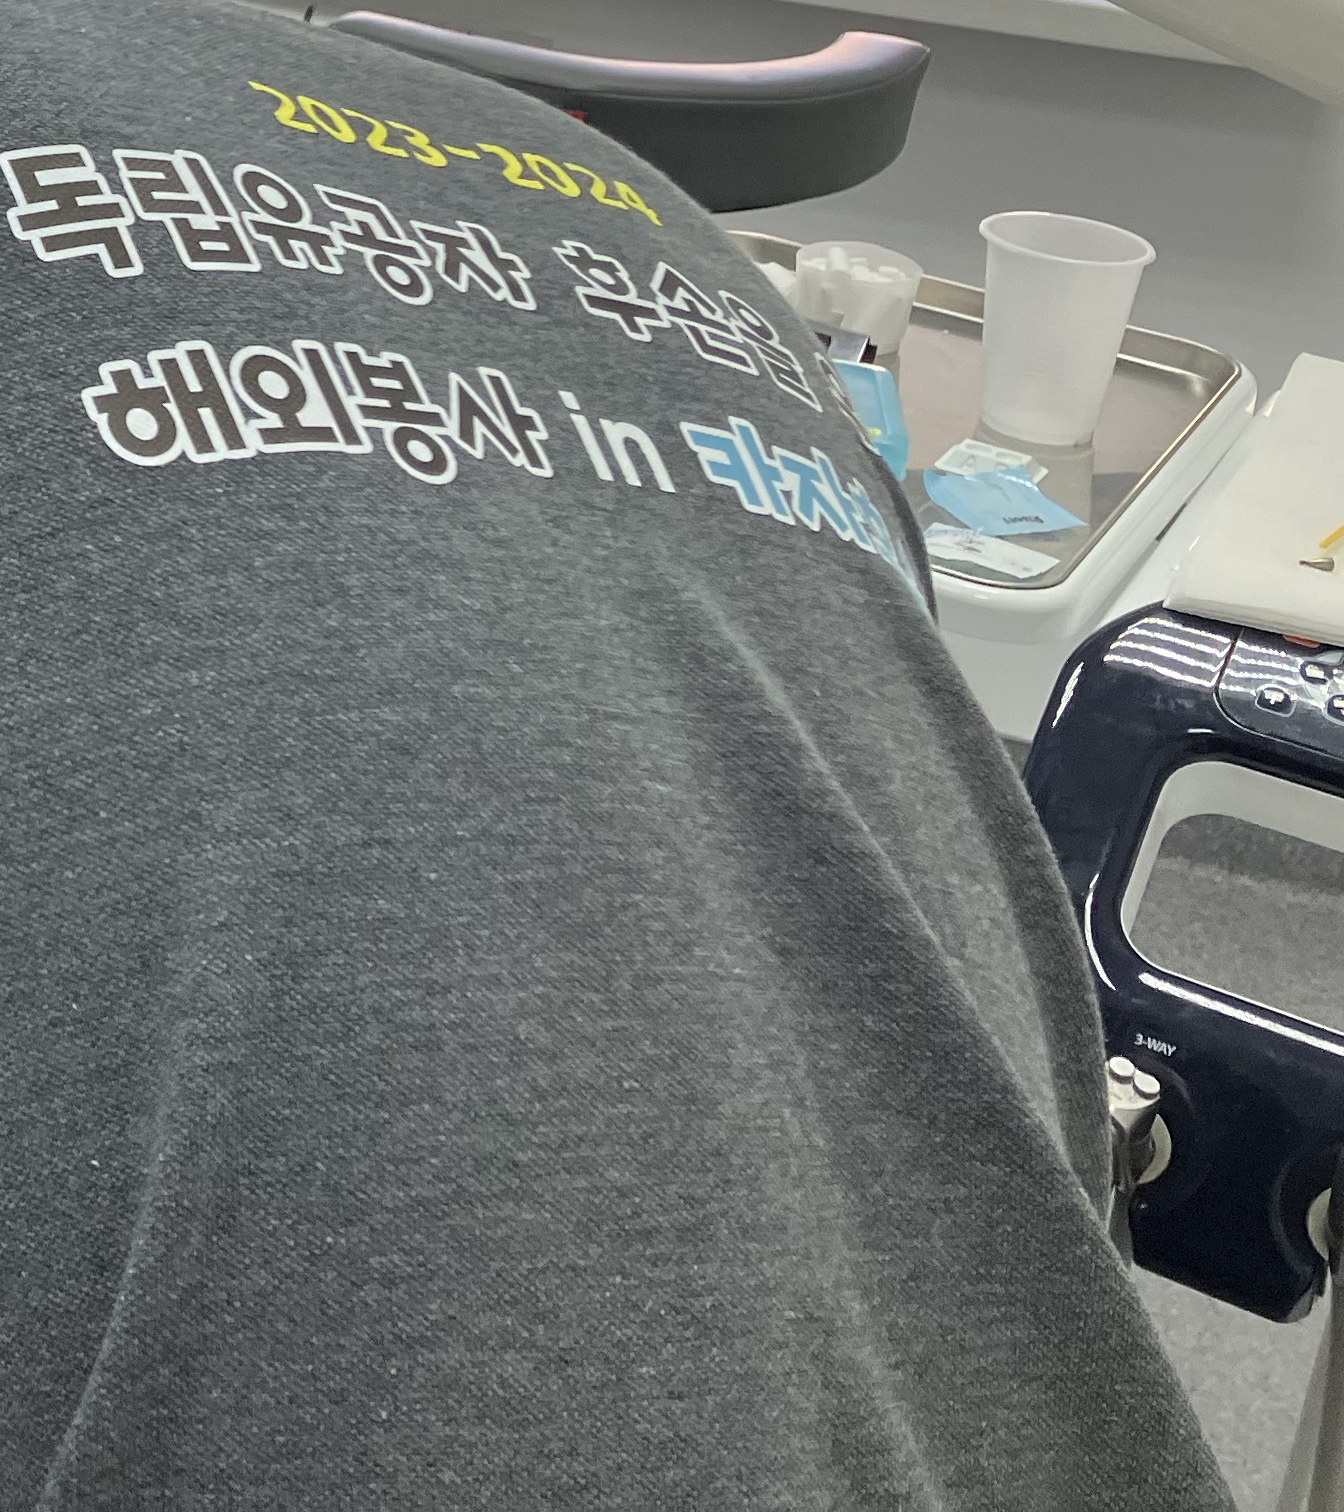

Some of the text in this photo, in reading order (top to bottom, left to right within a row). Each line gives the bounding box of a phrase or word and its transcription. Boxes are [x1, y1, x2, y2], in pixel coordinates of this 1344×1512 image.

[248, 81, 663, 226] 2023-2024
[551, 239, 823, 413] 후손을
[81, 340, 554, 484] 해외봉사
[558, 390, 676, 493] in
[1133, 1033, 1177, 1057] 3-WAY
